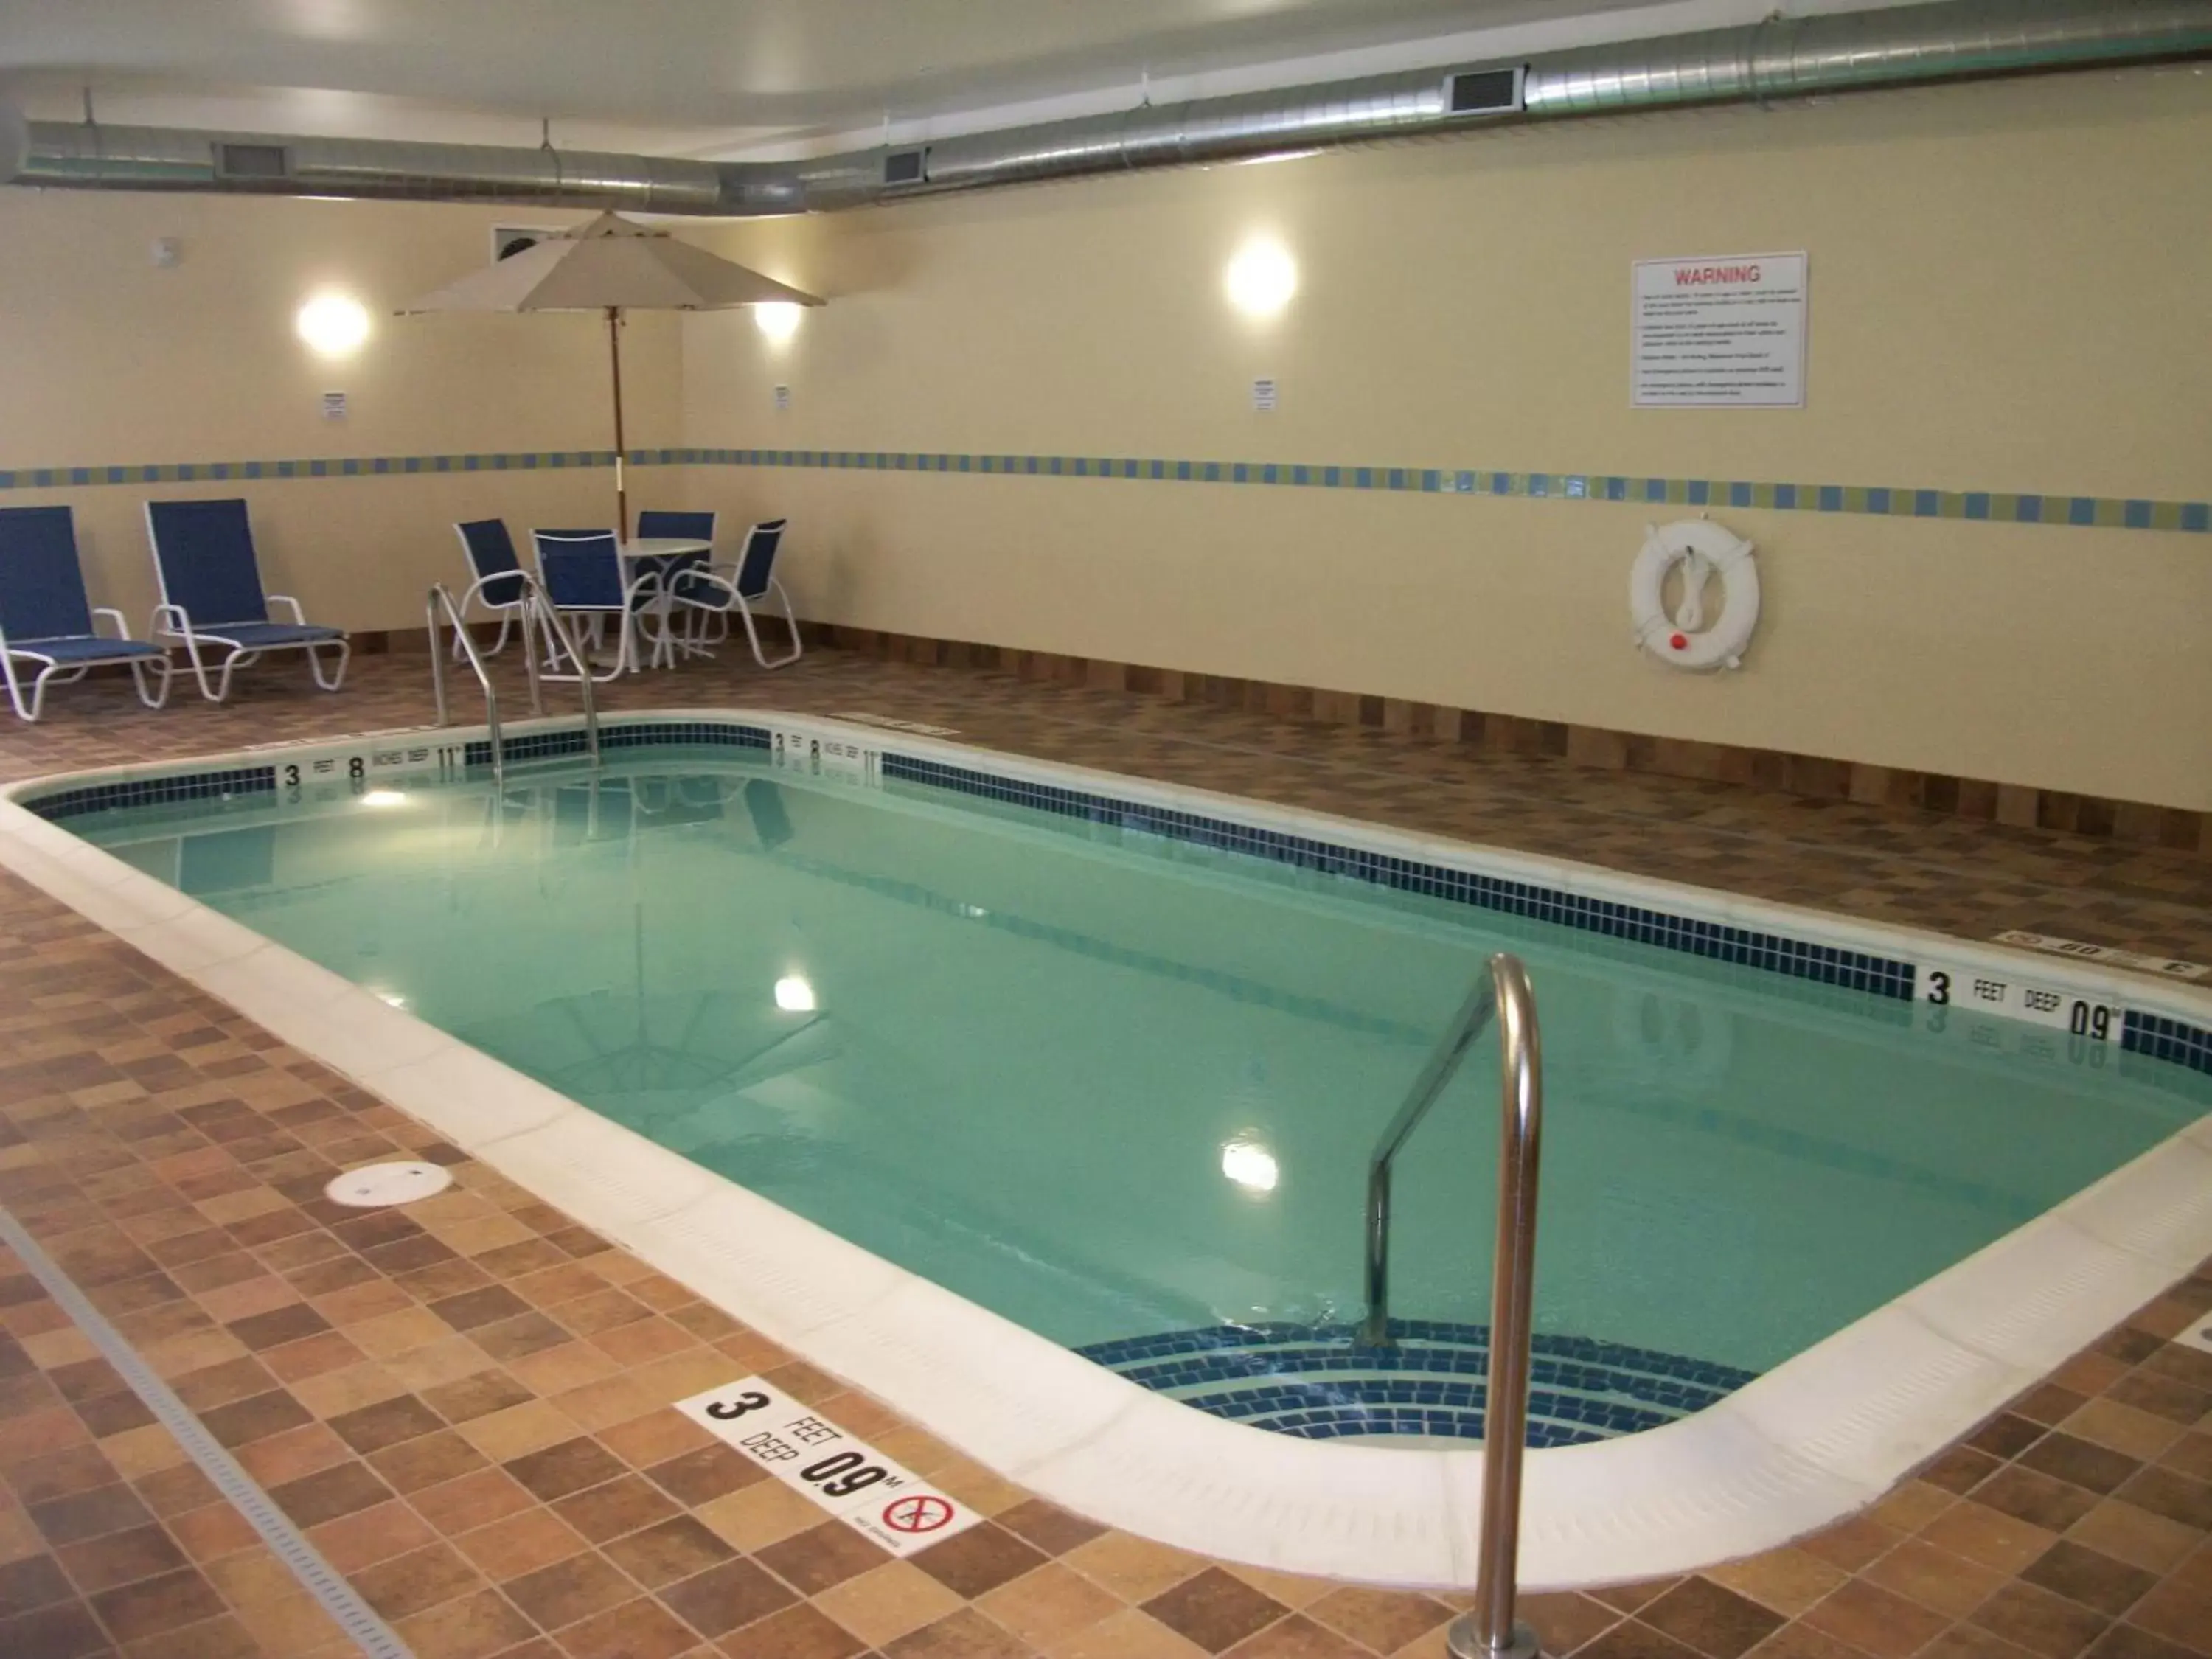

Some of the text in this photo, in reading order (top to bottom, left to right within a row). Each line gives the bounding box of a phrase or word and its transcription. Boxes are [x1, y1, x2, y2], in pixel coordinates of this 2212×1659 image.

[1674, 265, 1761, 286] WARNING
[285, 765, 300, 786] 3
[349, 757, 364, 778] 8
[1927, 971, 1950, 1005] 3
[1975, 979, 2006, 1001] FEET
[2025, 989, 2061, 1012] DEEP
[706, 1391, 771, 1420] 3
[784, 1416, 843, 1446] FEET
[740, 1431, 800, 1462] DEEP
